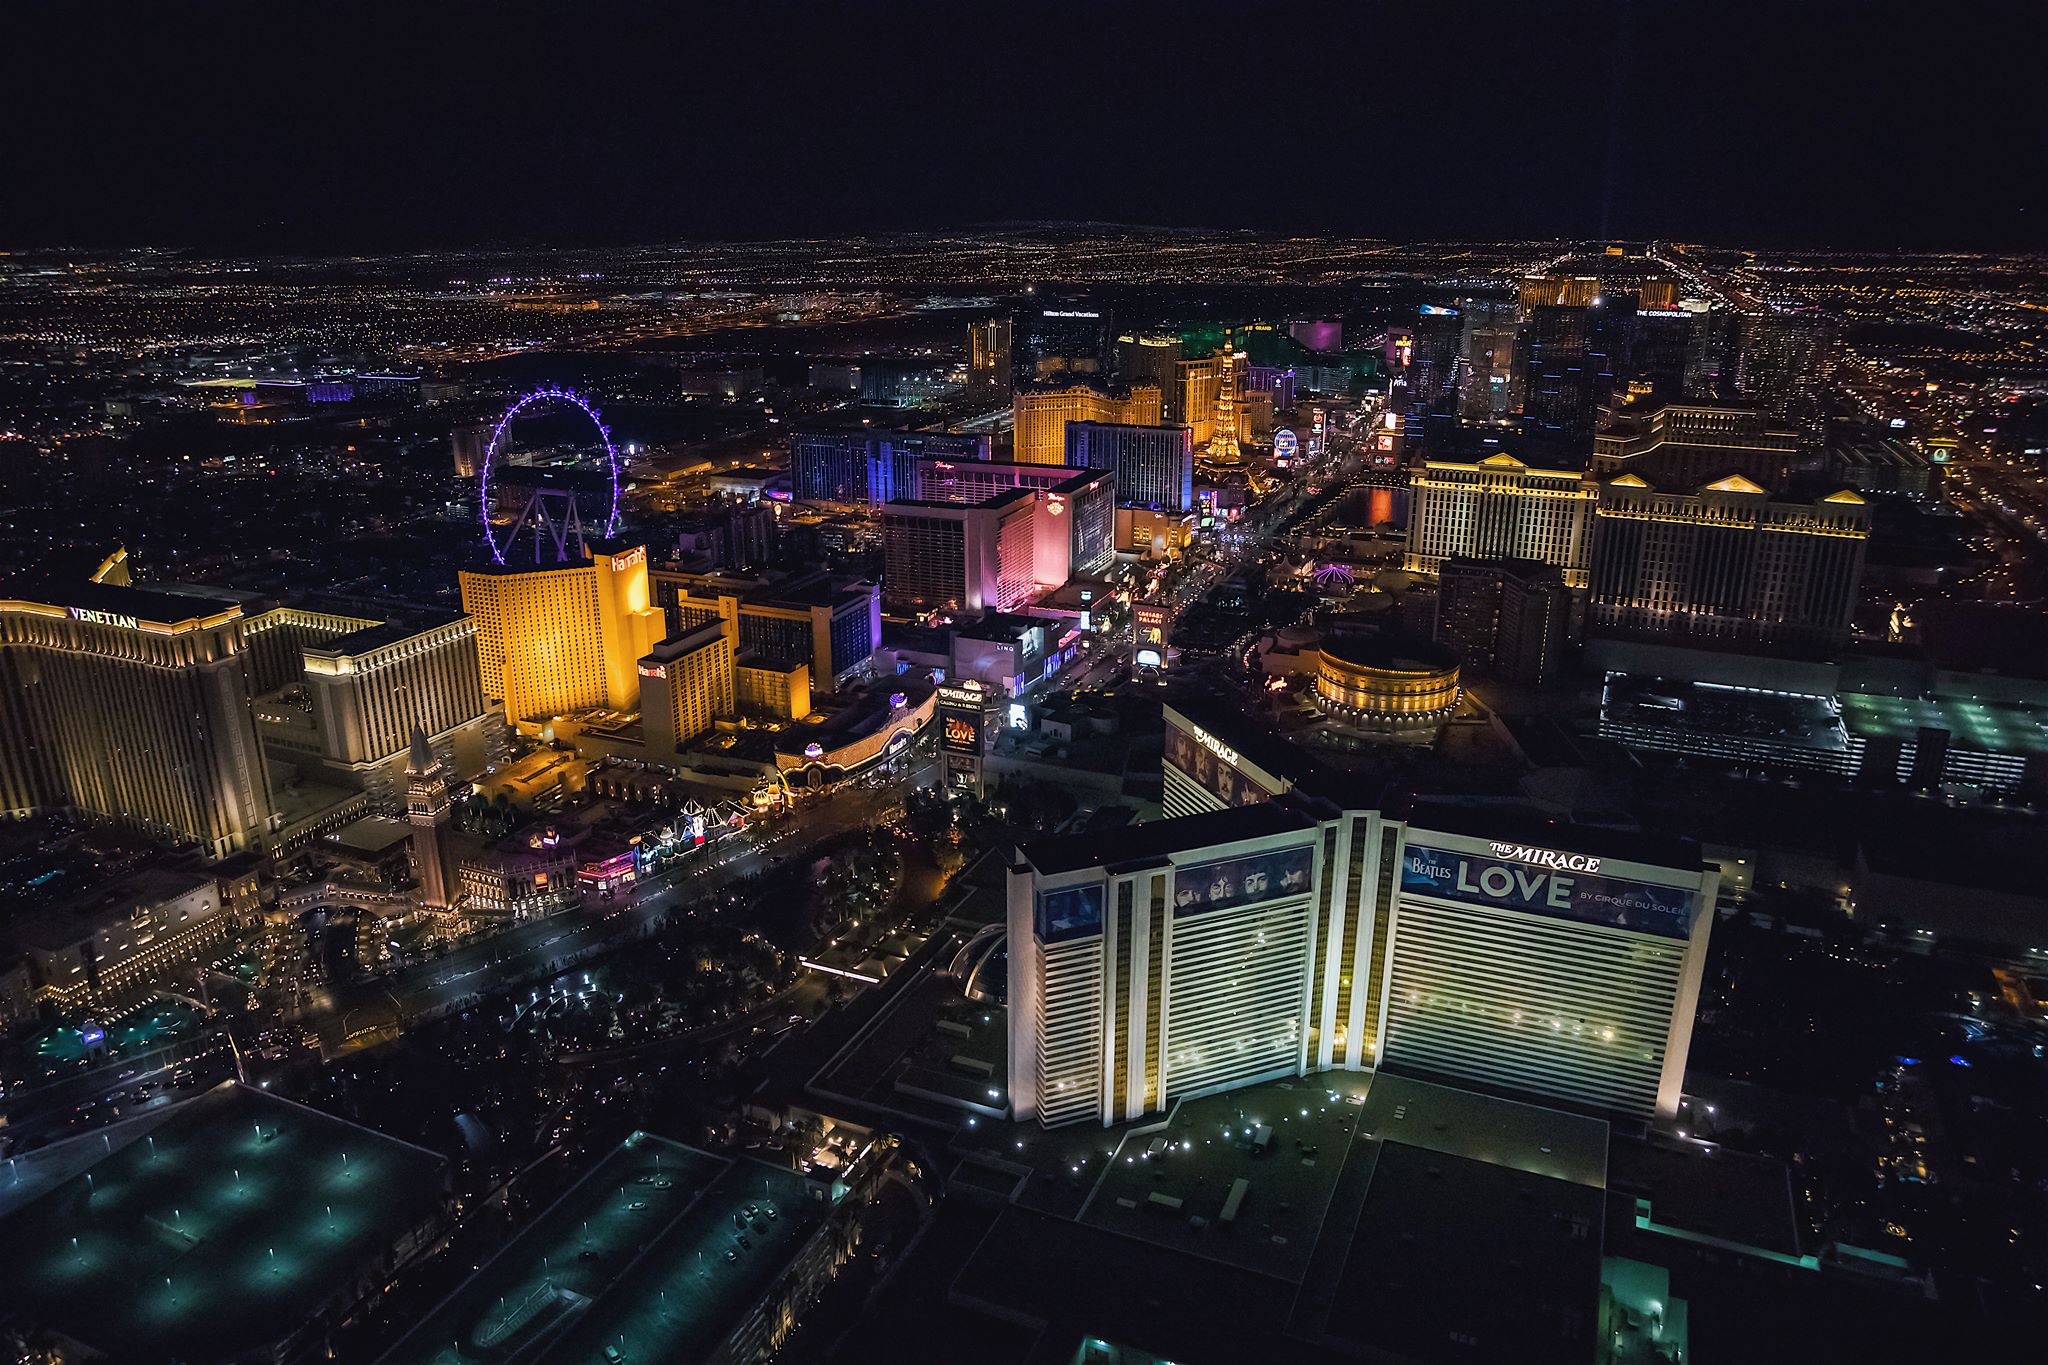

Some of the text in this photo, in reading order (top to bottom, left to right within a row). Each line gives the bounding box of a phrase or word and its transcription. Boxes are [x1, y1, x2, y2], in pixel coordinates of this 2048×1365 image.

[1649, 310, 1692, 318] COSMOPOLITAN
[70, 607, 137, 629] VENETIAN
[1138, 611, 1163, 619] CAESARS
[1138, 616, 1162, 625] PALACE
[941, 690, 983, 702] MIRAGE
[945, 727, 976, 742] LOVE
[1195, 730, 1239, 766] MIRAGE
[1412, 857, 1452, 879] BEATLES
[1489, 842, 1601, 873] THE MIRAGE
[1457, 861, 1575, 909] LOVE
[1580, 891, 1686, 916] BY CIRQUE DU SOLEIL
